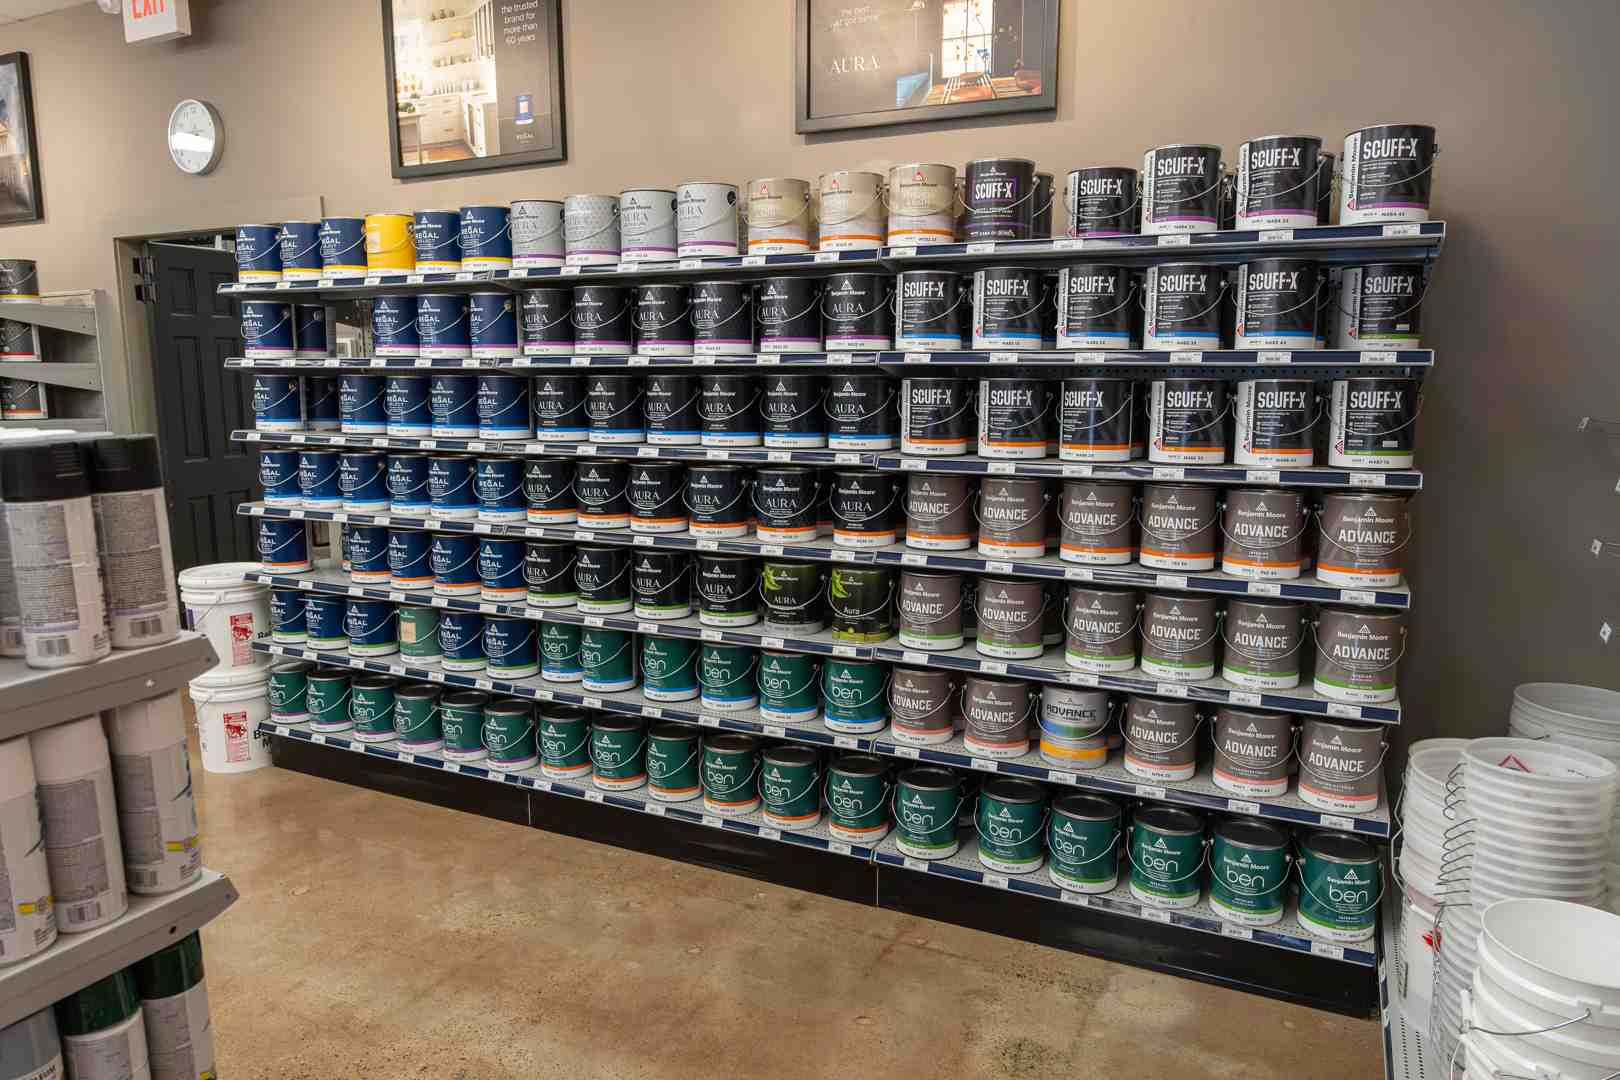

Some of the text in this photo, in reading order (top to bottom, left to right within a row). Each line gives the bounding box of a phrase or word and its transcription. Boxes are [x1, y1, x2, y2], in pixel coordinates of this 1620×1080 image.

[1363, 138, 1418, 160] SCUFF-X
[1158, 156, 1205, 176] SCUFF-X
[1251, 148, 1302, 169] SCUFF-X
[975, 182, 1012, 200] SCUFF-X
[1080, 178, 1123, 196] SCUFF-X
[904, 281, 944, 298] SCUFF-X
[986, 279, 1029, 297] SCUFF-X
[1070, 275, 1115, 293] SCUFF-X
[1160, 275, 1207, 292] SCUFF-X
[1249, 272, 1300, 290] SCUFF-X
[1364, 275, 1414, 294] SCUFF-X
[912, 388, 952, 405] SCUFF-X
[990, 389, 1033, 406] SCUFF-X
[1064, 391, 1104, 407] SCUFF-X
[1167, 391, 1213, 408] SCUFF-X
[1257, 391, 1306, 409] SCUFF-X
[1350, 391, 1402, 409] SCUFF-X
[984, 508, 1028, 521] ADVANCE
[1069, 512, 1117, 525] ADVANCE
[1148, 518, 1201, 530] ADVANCE
[1234, 523, 1288, 538] ADVANCE
[1338, 529, 1395, 544] ADVANCE
[902, 601, 943, 615] ADVANCE
[982, 607, 1028, 622] ADVANCE
[1073, 618, 1123, 634] ADVANCE
[1150, 624, 1202, 640] ADVANCE
[1234, 632, 1288, 648] ADVANCE
[1333, 644, 1392, 660] ADVANCE
[893, 695, 932, 711] ADVANCE
[970, 710, 1015, 723] ADVANCE
[1130, 726, 1179, 743] ADVANCE
[1225, 742, 1278, 758] ADVANCE
[1309, 752, 1366, 772] ADVANCE
